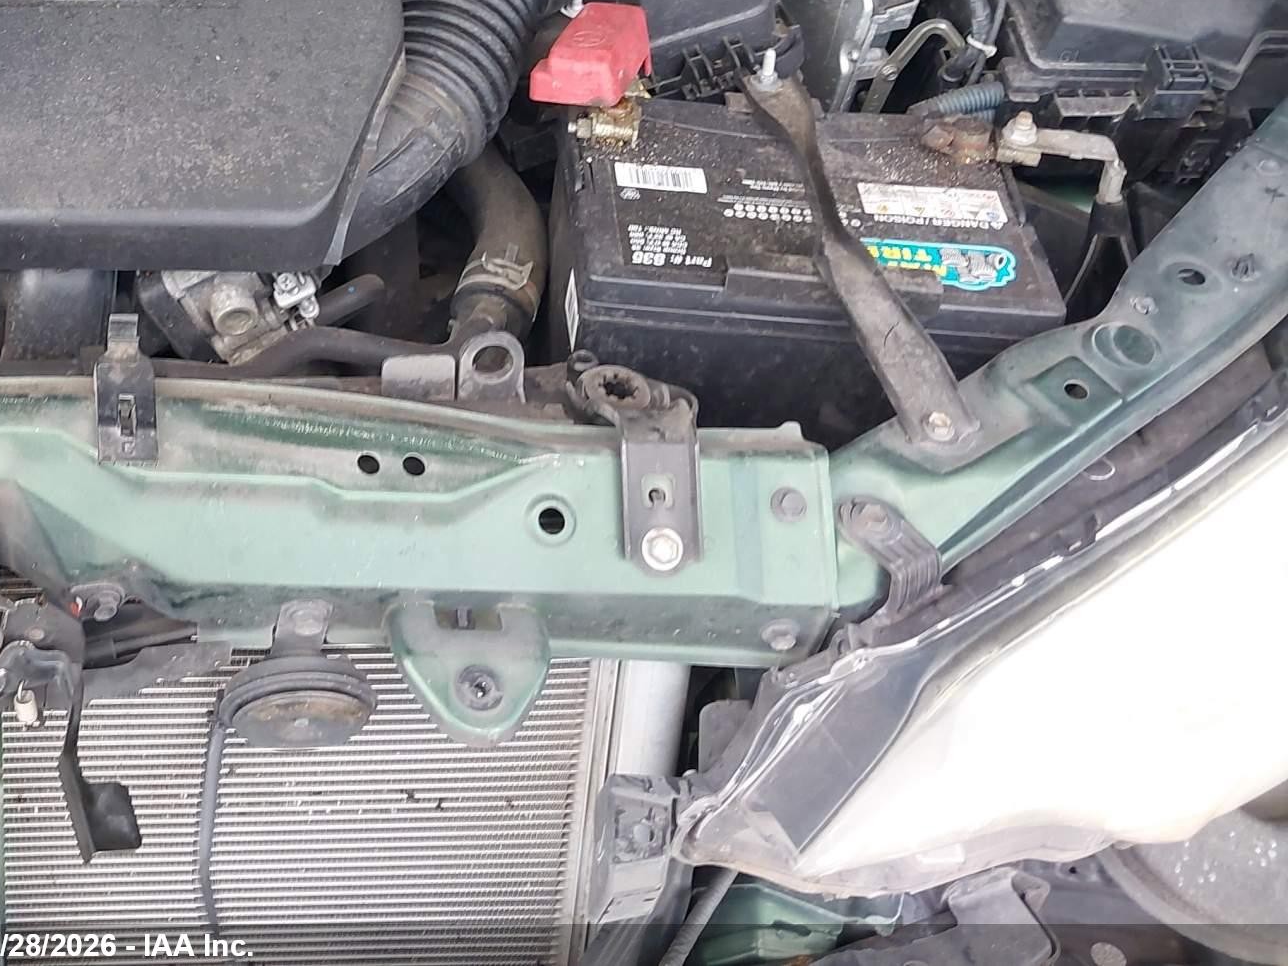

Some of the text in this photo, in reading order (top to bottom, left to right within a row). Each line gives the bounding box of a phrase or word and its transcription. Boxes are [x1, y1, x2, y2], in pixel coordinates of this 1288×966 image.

[873, 214, 925, 226] POISON
[932, 217, 990, 230] DANGER
[685, 255, 713, 268] Part
